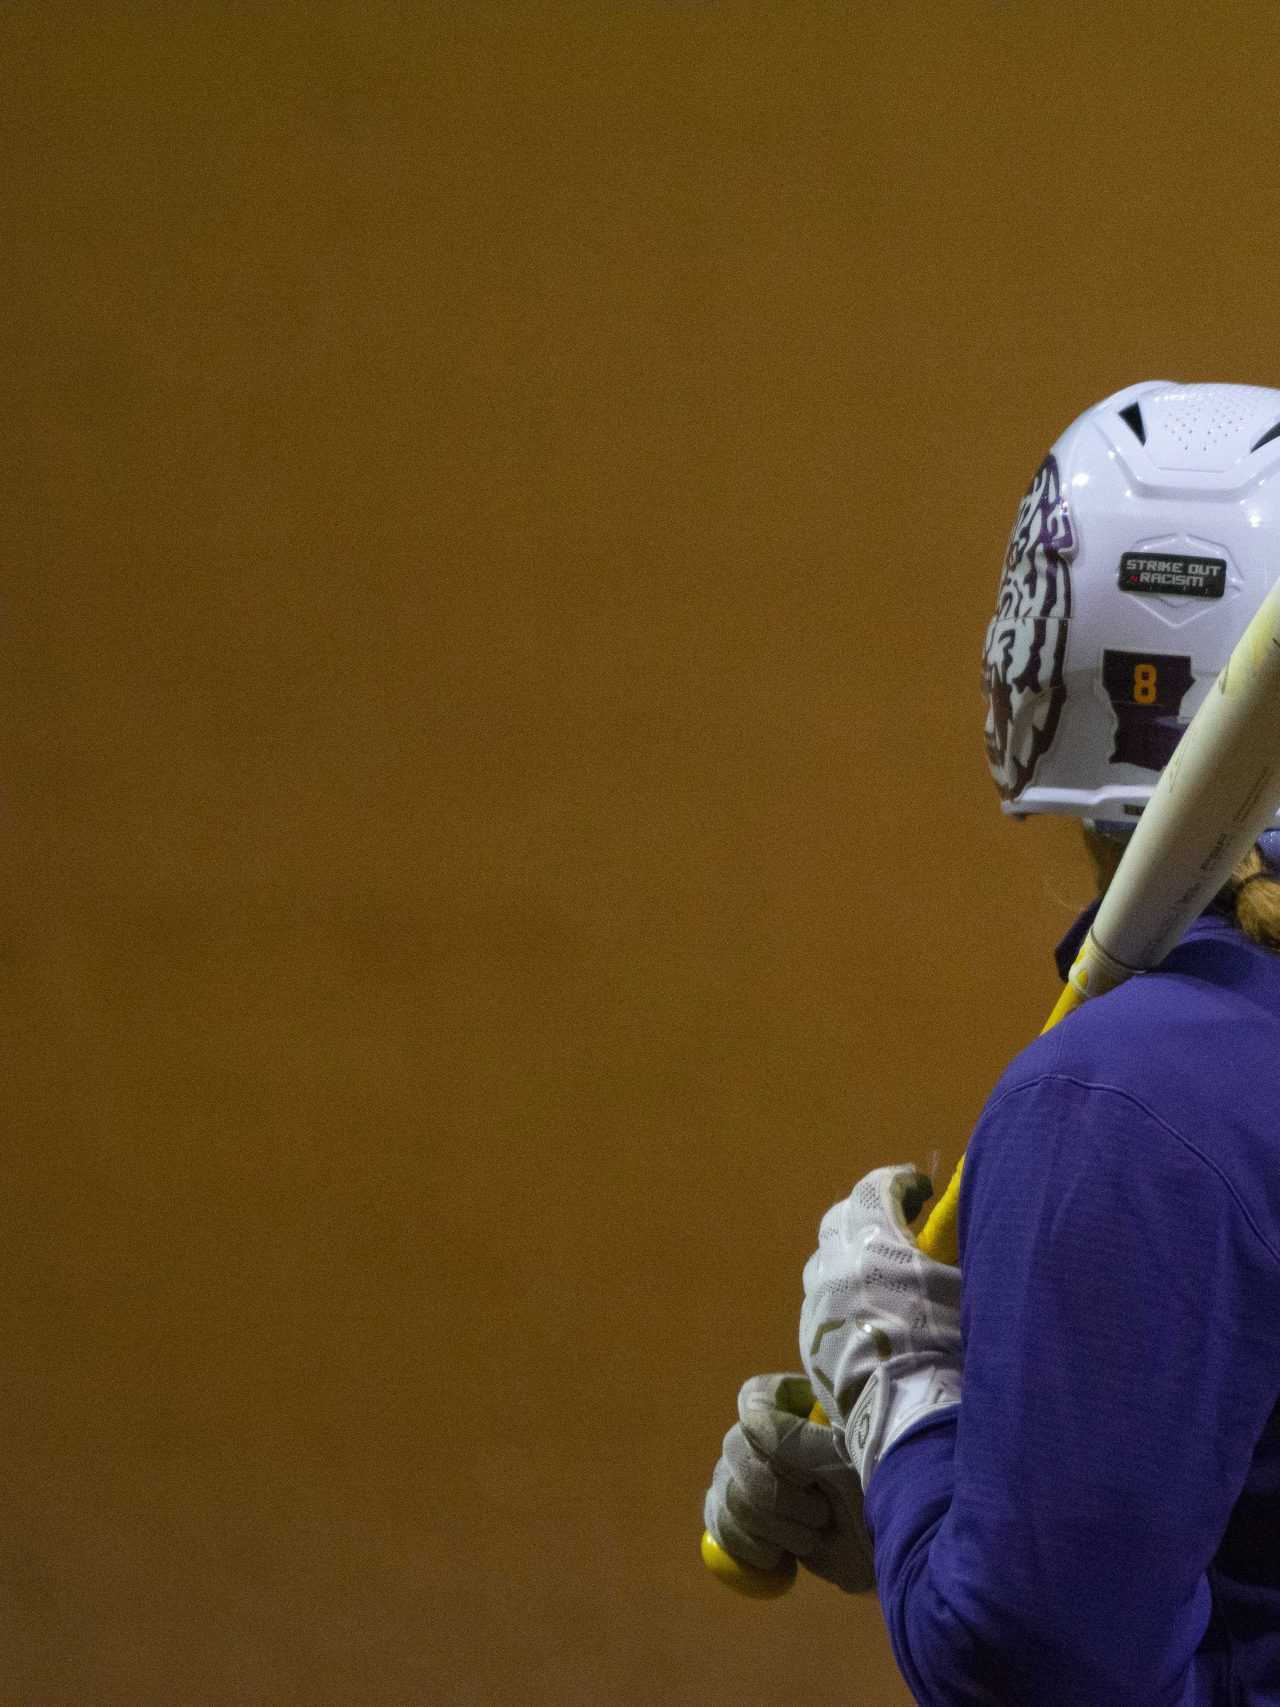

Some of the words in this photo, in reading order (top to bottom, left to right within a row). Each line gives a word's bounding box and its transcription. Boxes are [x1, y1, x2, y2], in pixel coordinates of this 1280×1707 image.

[1125, 559, 1184, 574] STRIKE
[1188, 563, 1222, 577] OUT
[1139, 571, 1206, 588] RACISM
[1134, 663, 1157, 705] 8
